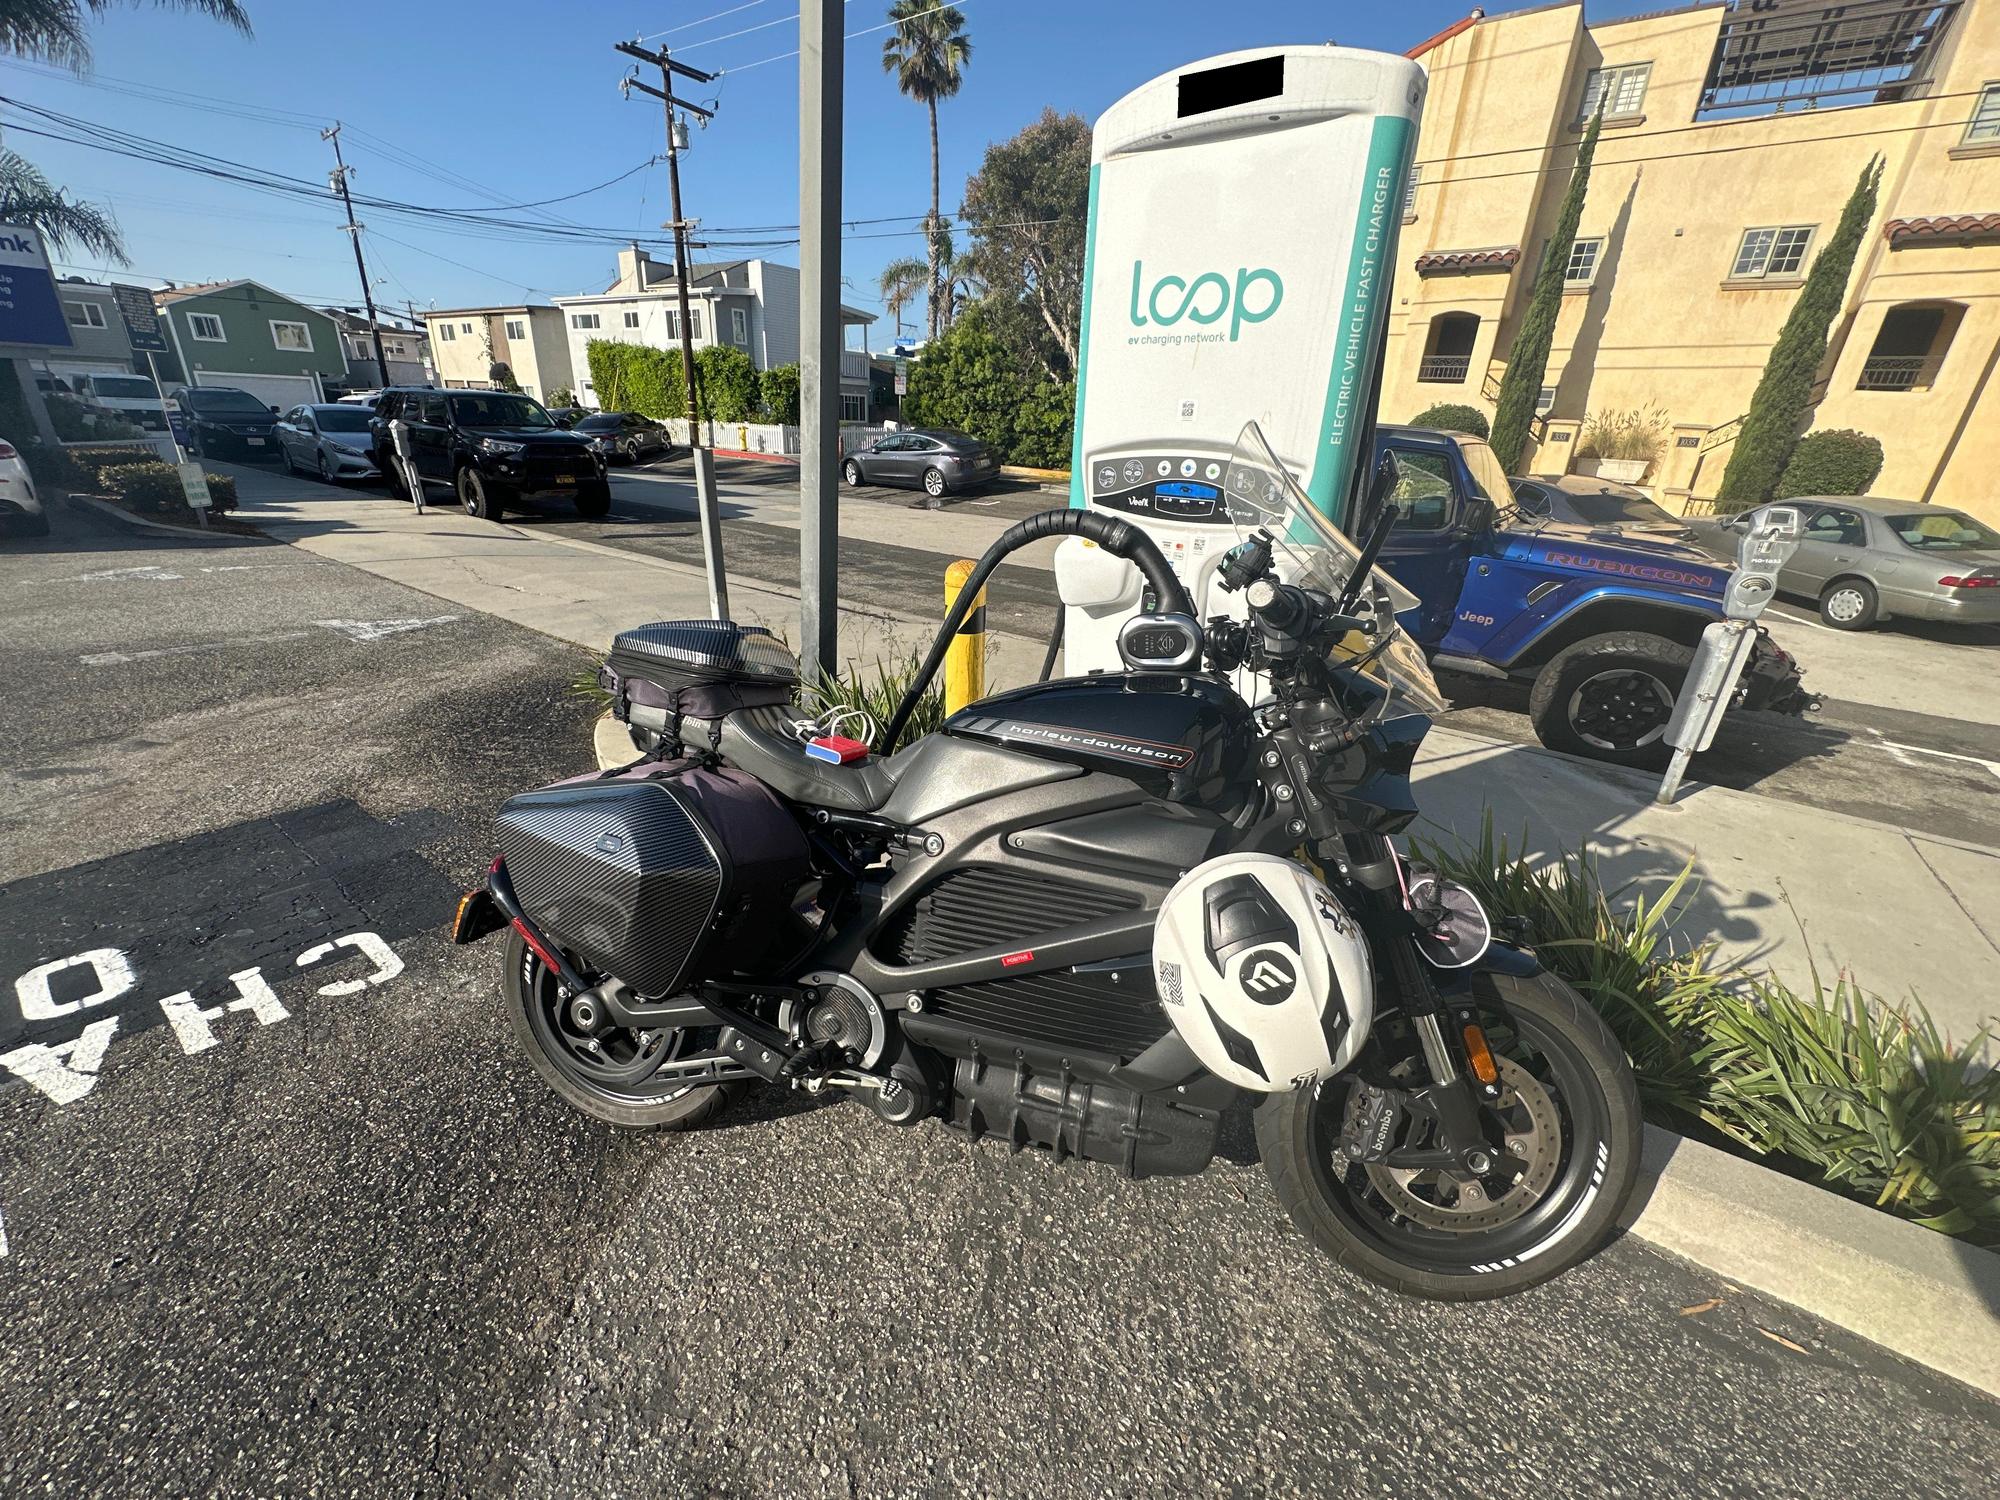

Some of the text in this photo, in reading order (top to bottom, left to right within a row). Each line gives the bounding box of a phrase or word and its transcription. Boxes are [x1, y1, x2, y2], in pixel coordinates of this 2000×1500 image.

[1130, 260, 1284, 342] loop
[1330, 166, 1392, 446] ELECTRIC VEHICLE FAST CHARGER
[1128, 331, 1226, 346] ev charging network
[1545, 551, 1713, 588] RUBICON
[1459, 610, 1494, 627] Jeep
[1009, 724, 1184, 763] harley-davidson
[1371, 1109, 1393, 1151] brembo
